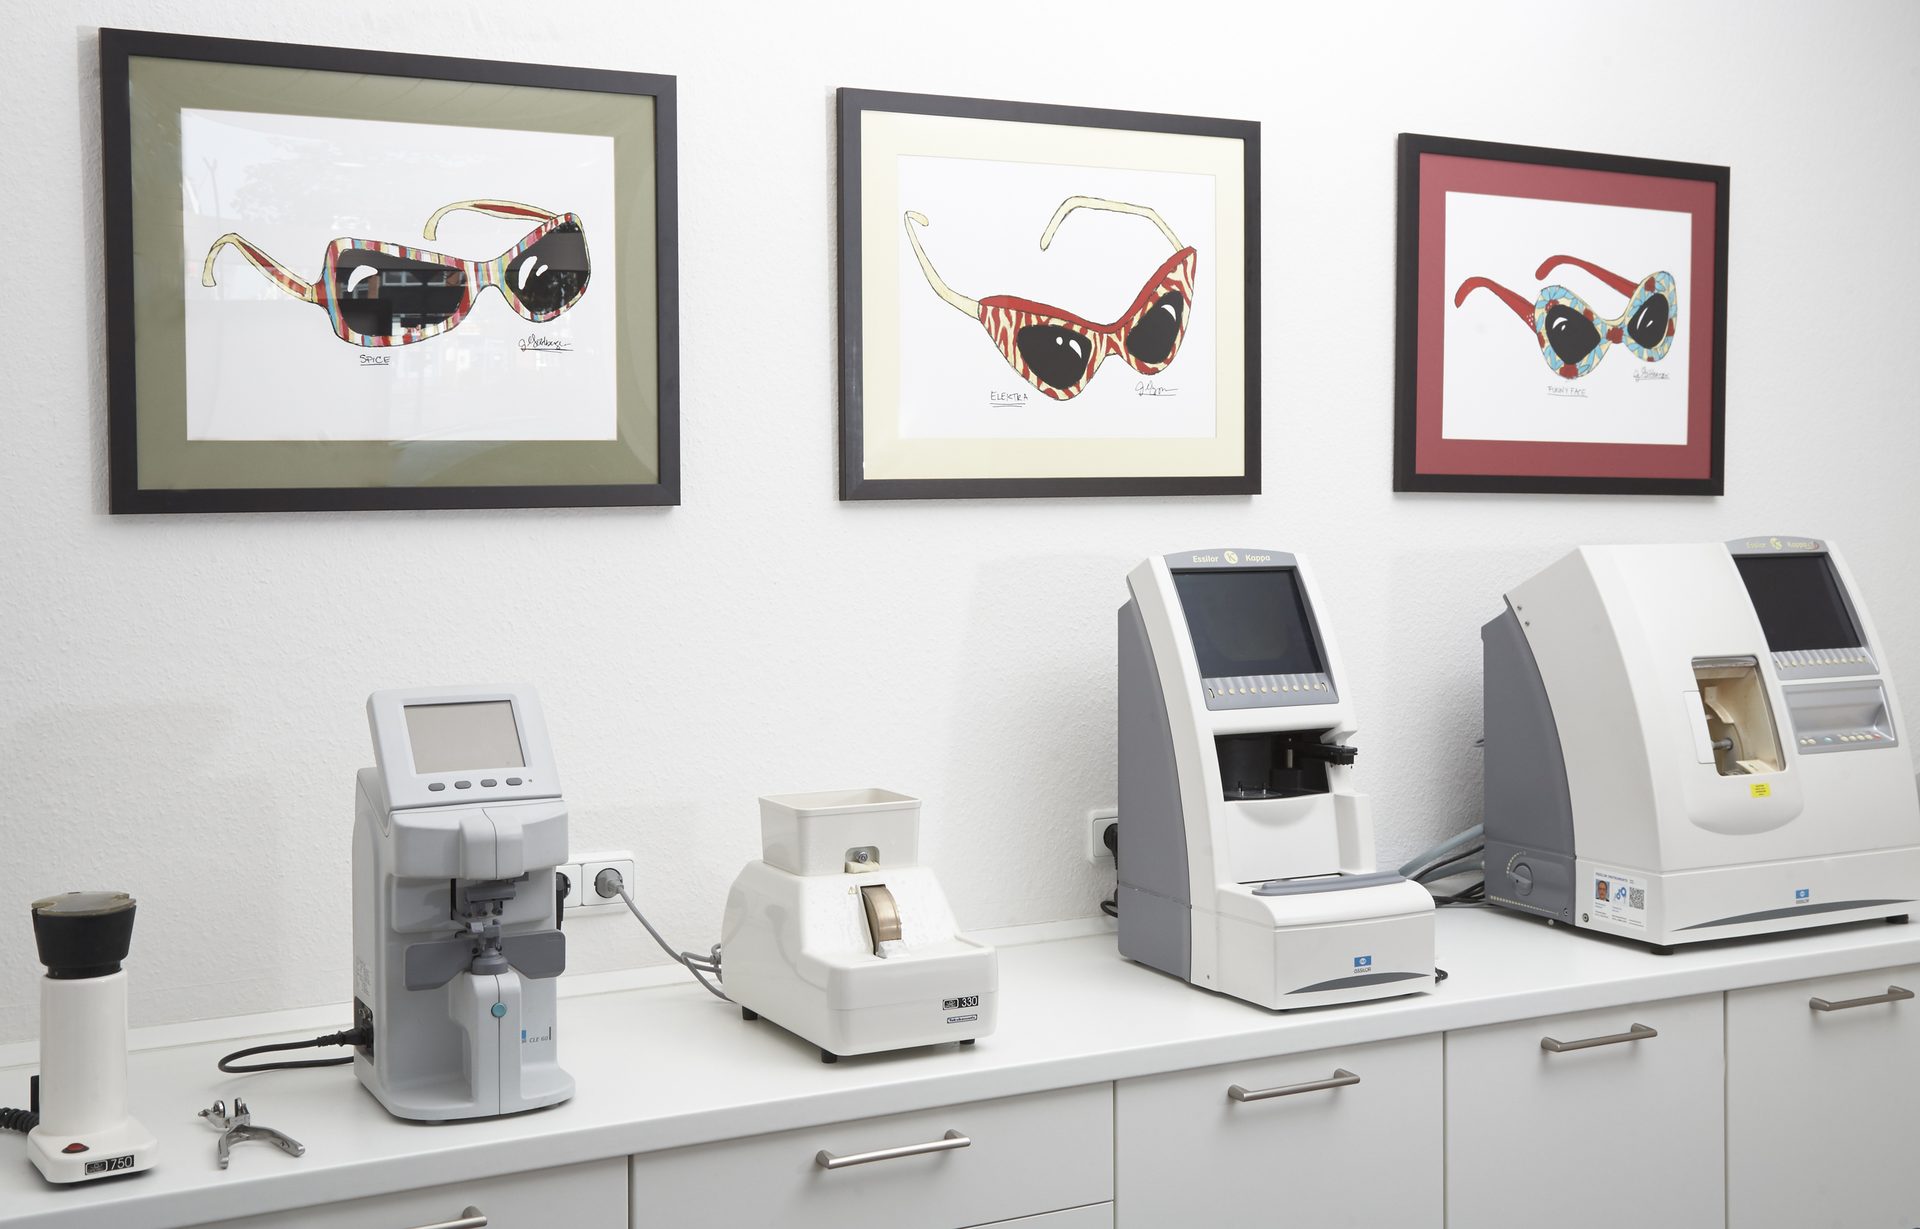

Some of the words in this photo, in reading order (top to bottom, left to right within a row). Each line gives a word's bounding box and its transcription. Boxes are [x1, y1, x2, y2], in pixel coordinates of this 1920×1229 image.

[360, 354, 390, 364] SPICE
[990, 391, 1028, 401] ELEKTRA
[1192, 555, 1218, 563] Essilor
[1245, 554, 1271, 563] Kappa
[961, 996, 977, 1007] 330
[111, 1156, 133, 1170] 750
